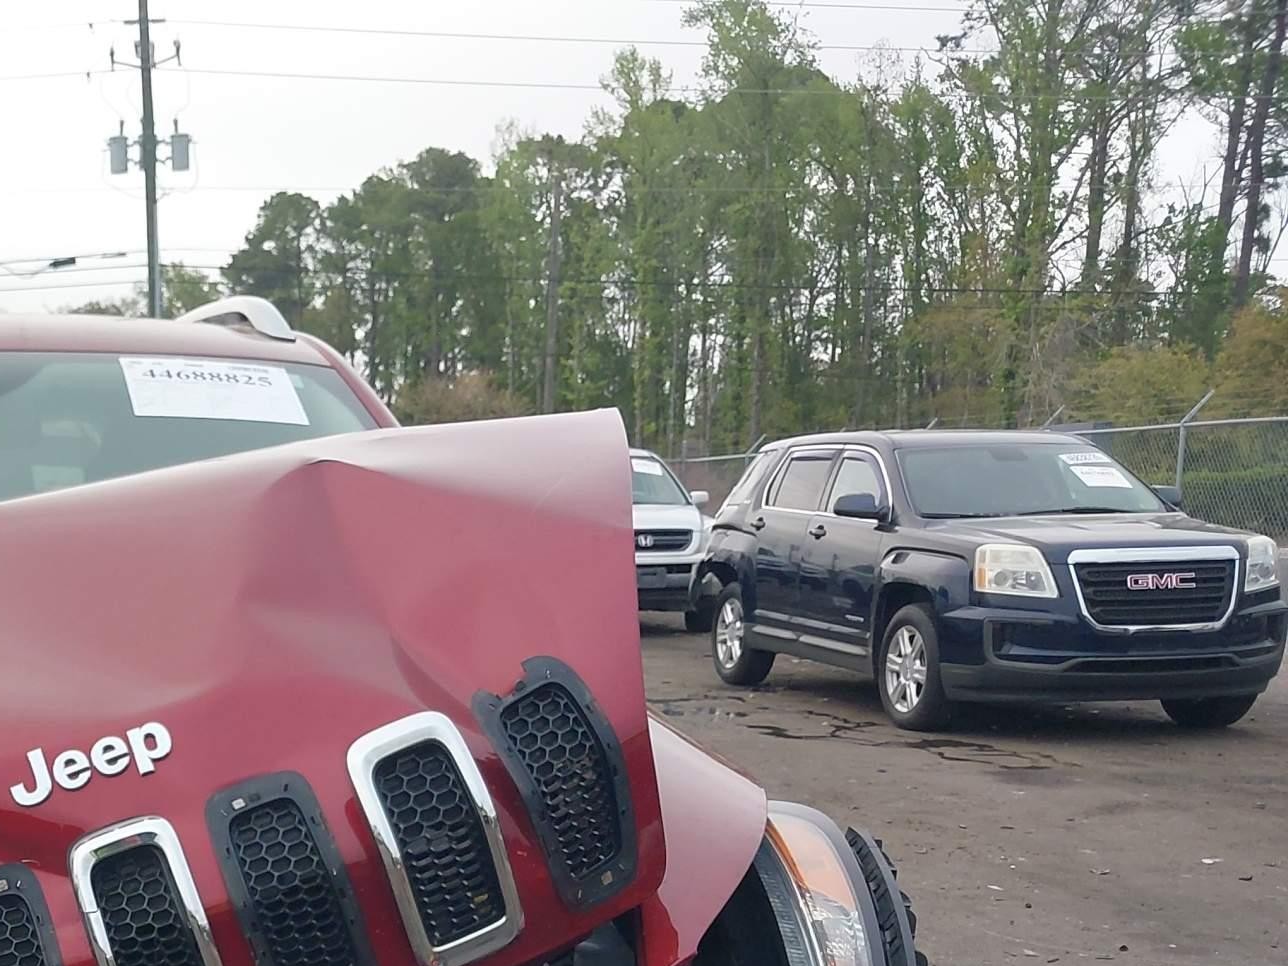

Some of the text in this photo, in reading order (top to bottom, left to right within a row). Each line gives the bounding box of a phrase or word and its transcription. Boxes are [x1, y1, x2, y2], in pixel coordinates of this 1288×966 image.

[141, 368, 273, 388] 44688825
[1126, 571, 1197, 591] GMC
[10, 721, 172, 807] Jeep
